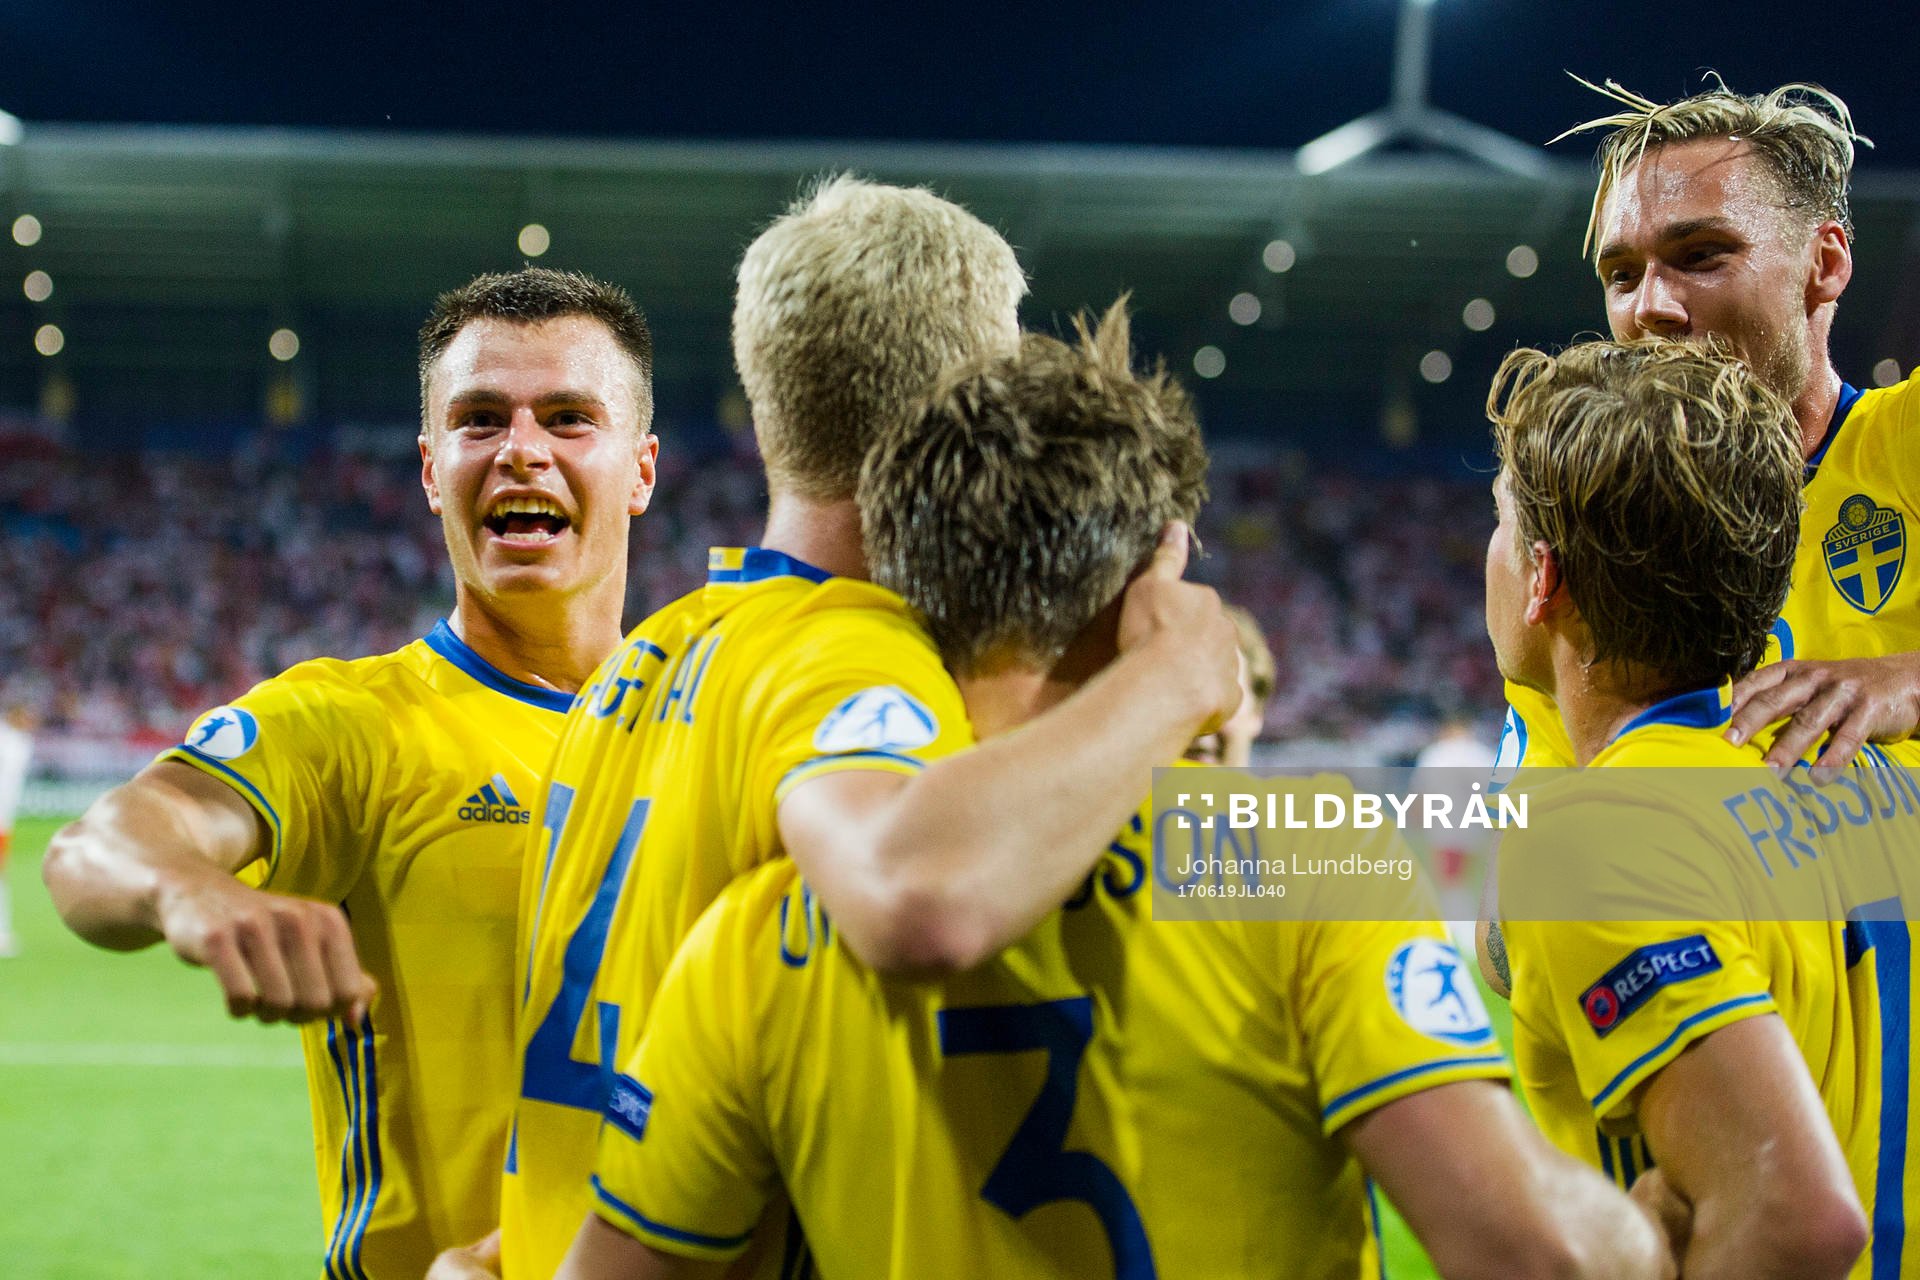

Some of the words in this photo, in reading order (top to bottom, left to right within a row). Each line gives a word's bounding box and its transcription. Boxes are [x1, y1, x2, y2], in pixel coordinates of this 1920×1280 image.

[1835, 524, 1890, 550] SVERIGE
[458, 804, 530, 824] adidas
[1613, 943, 1711, 1002] RESPECT
